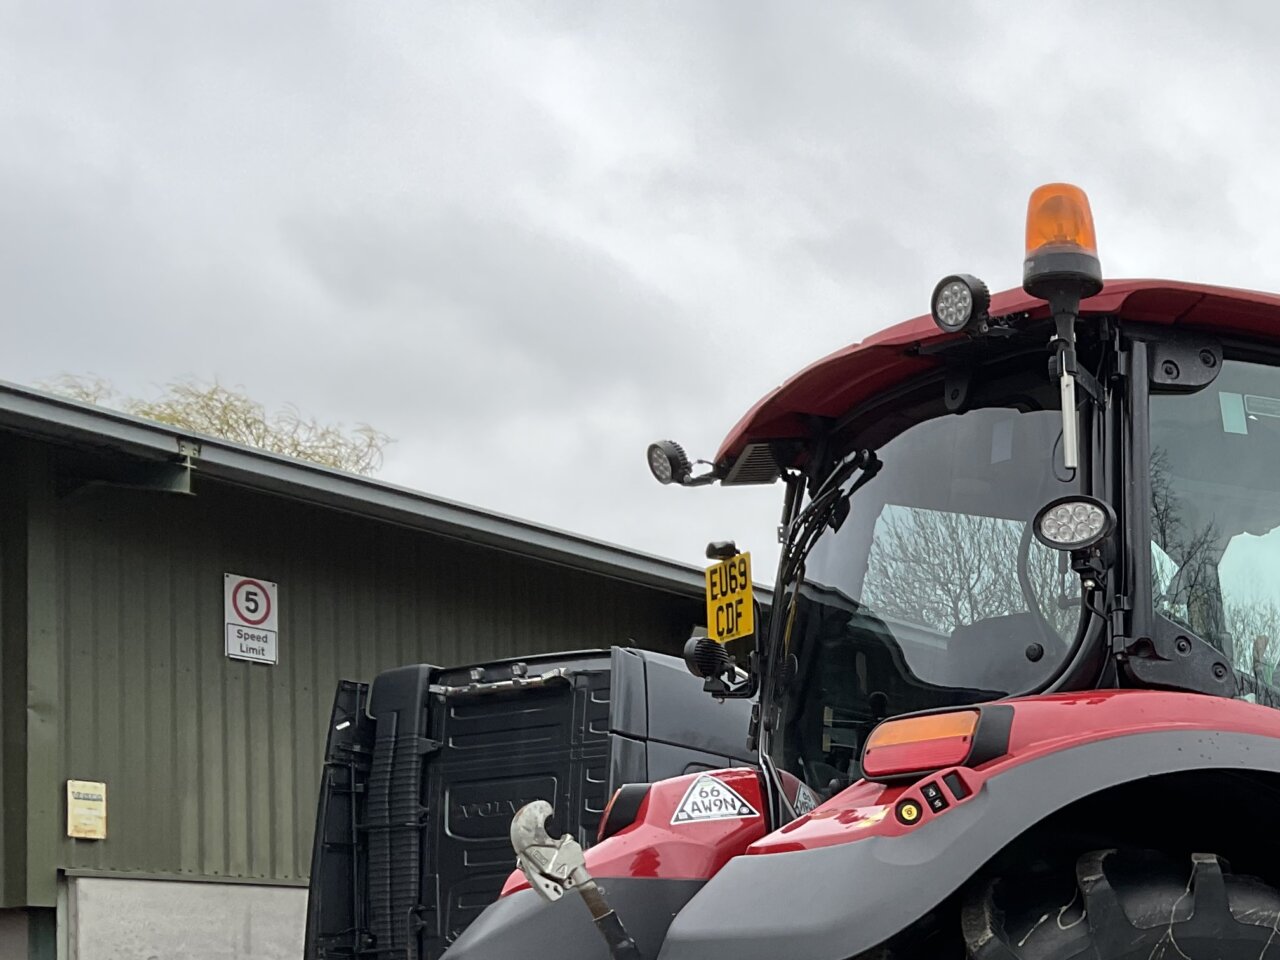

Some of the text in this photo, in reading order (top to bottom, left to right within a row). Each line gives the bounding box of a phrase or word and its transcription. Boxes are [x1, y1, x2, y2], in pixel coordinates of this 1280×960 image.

[709, 557, 748, 601] EU69
[245, 590, 259, 614] 5
[716, 598, 743, 637] CDF
[236, 628, 268, 644] Speed
[240, 643, 265, 657] Limit
[698, 785, 720, 799] 66
[691, 797, 737, 815] AW9N
